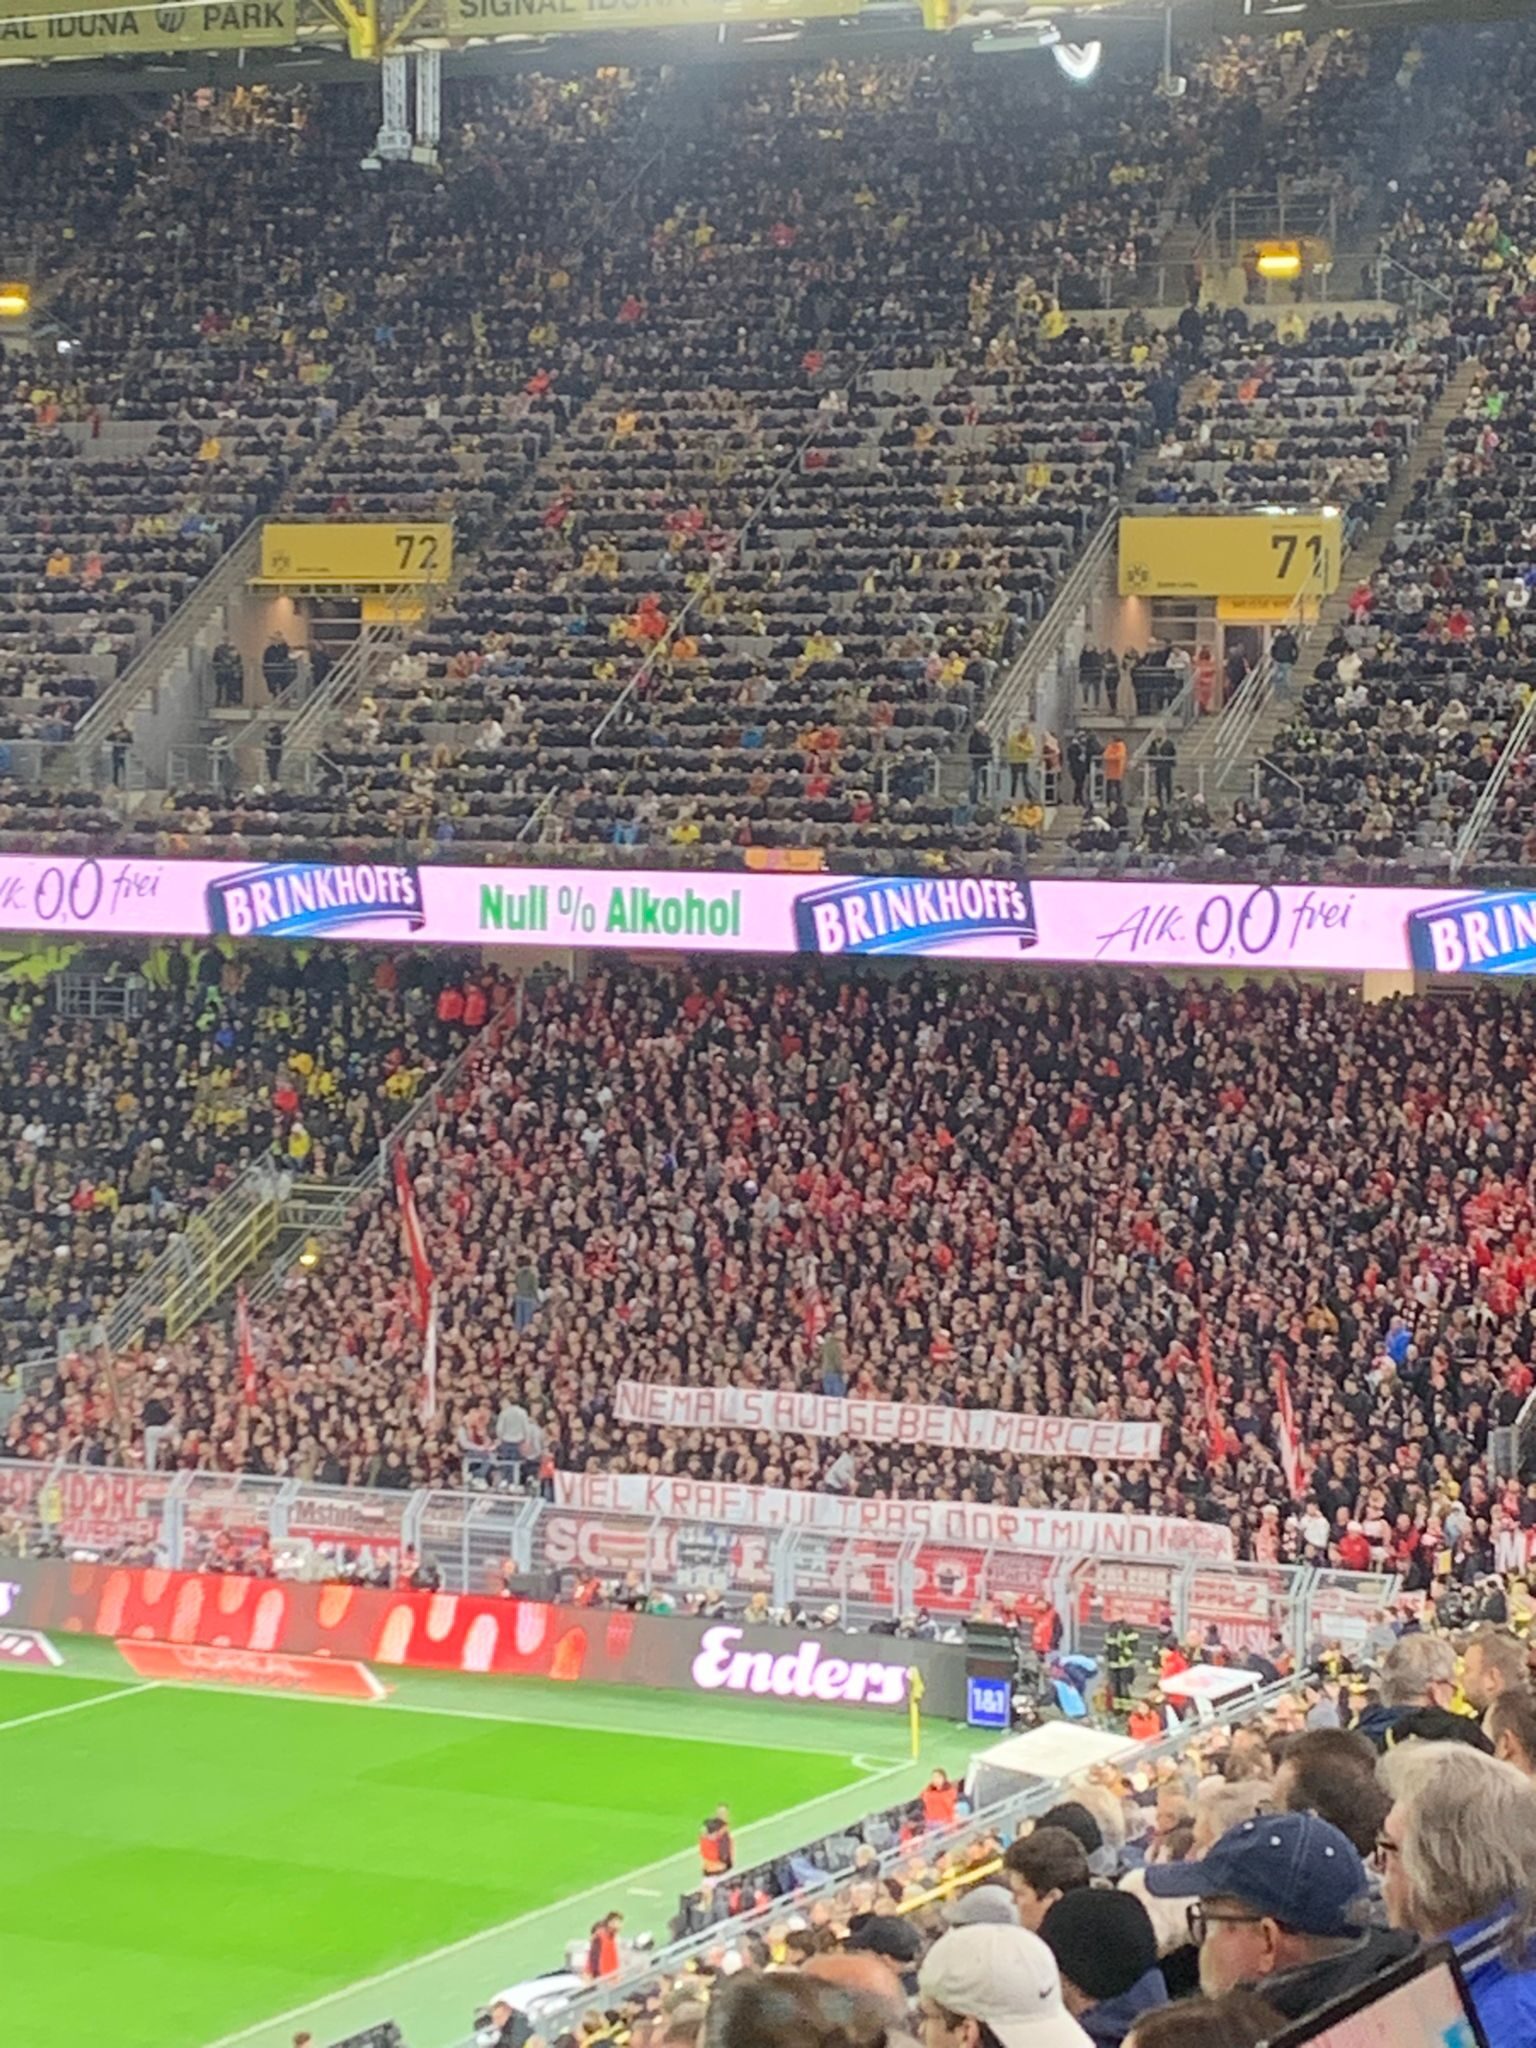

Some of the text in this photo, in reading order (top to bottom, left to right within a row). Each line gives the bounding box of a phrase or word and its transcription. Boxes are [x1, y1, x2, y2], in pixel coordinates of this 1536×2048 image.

[49, 11, 140, 38] IDUNA
[203, 2, 285, 31] PARK
[395, 534, 439, 570] 72
[1271, 534, 1324, 579] 71
[109, 863, 165, 916] frei
[479, 883, 742, 937] Null % Alkohol
[1095, 904, 1186, 958] Alk.
[1288, 890, 1356, 949] frei
[1428, 900, 1536, 973] BRIN
[617, 1383, 764, 1426] NIEMALS
[990, 1414, 1153, 1459] MARCEL!
[559, 1472, 632, 1512] VIEL
[693, 1625, 908, 1704] Enders
